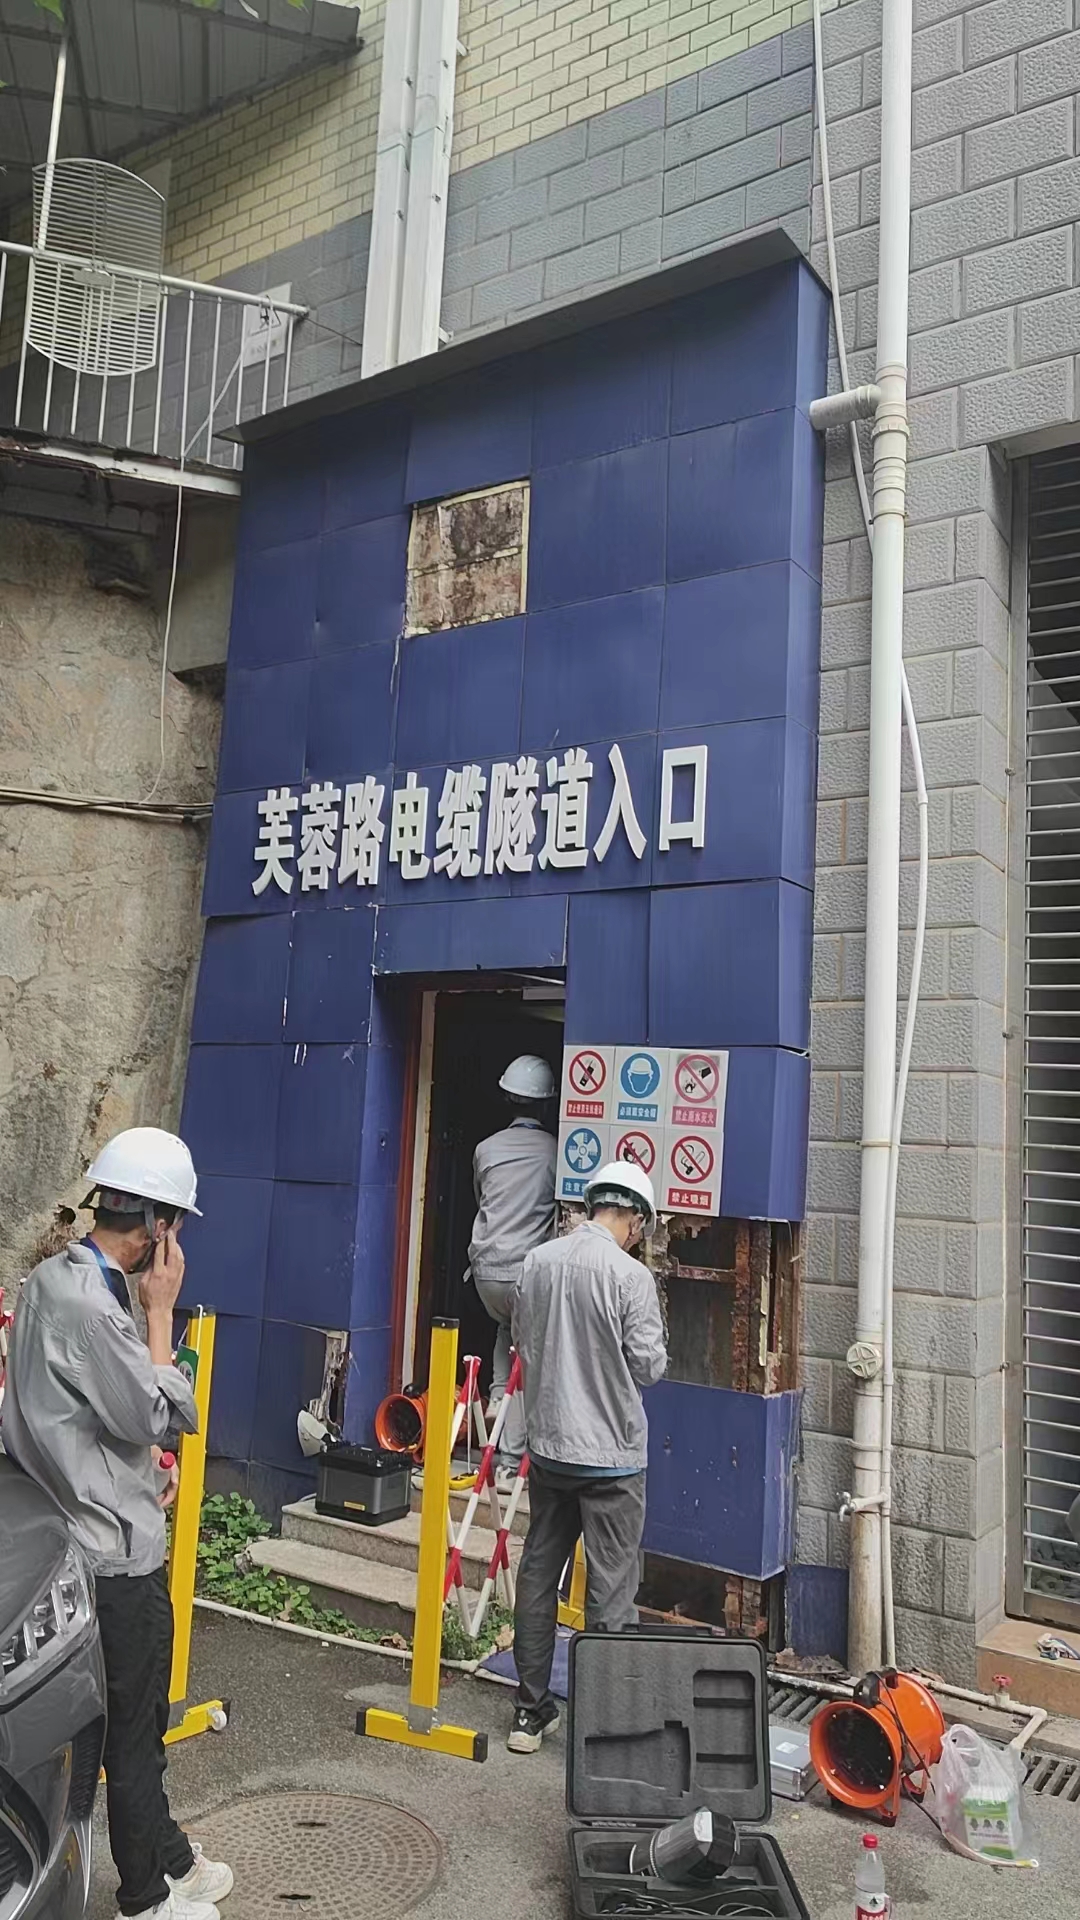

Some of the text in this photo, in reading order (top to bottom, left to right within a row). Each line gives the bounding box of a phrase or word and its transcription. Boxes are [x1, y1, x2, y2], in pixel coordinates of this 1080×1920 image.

[252, 743, 708, 895] 芙蓉路电缆隧道入口
[620, 1105, 656, 1119] 必须戴安全帽
[671, 1191, 709, 1206] 禁止吸烟
